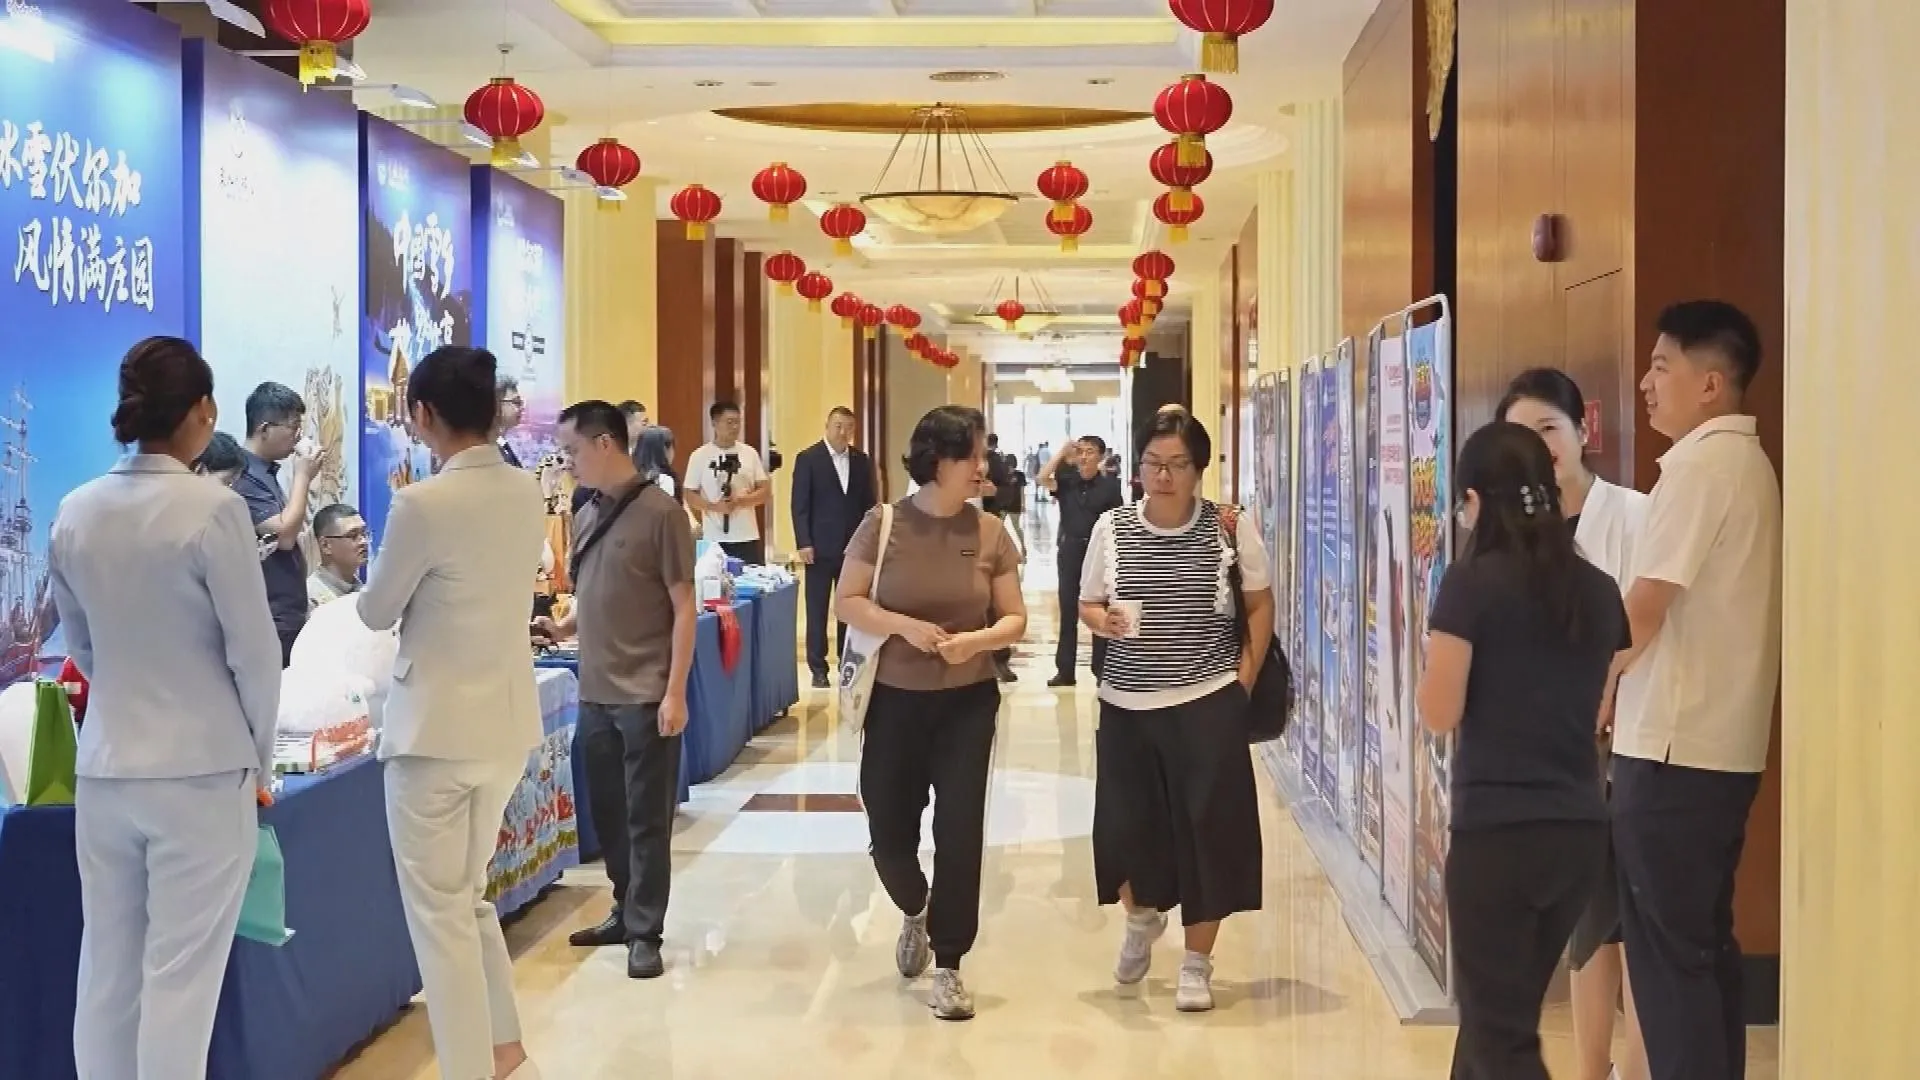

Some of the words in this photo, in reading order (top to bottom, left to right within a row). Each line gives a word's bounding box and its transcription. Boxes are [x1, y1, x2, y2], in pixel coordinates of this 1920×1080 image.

[14, 216, 153, 313] 风情满庄园
[393, 209, 454, 300] 中国雪乡
